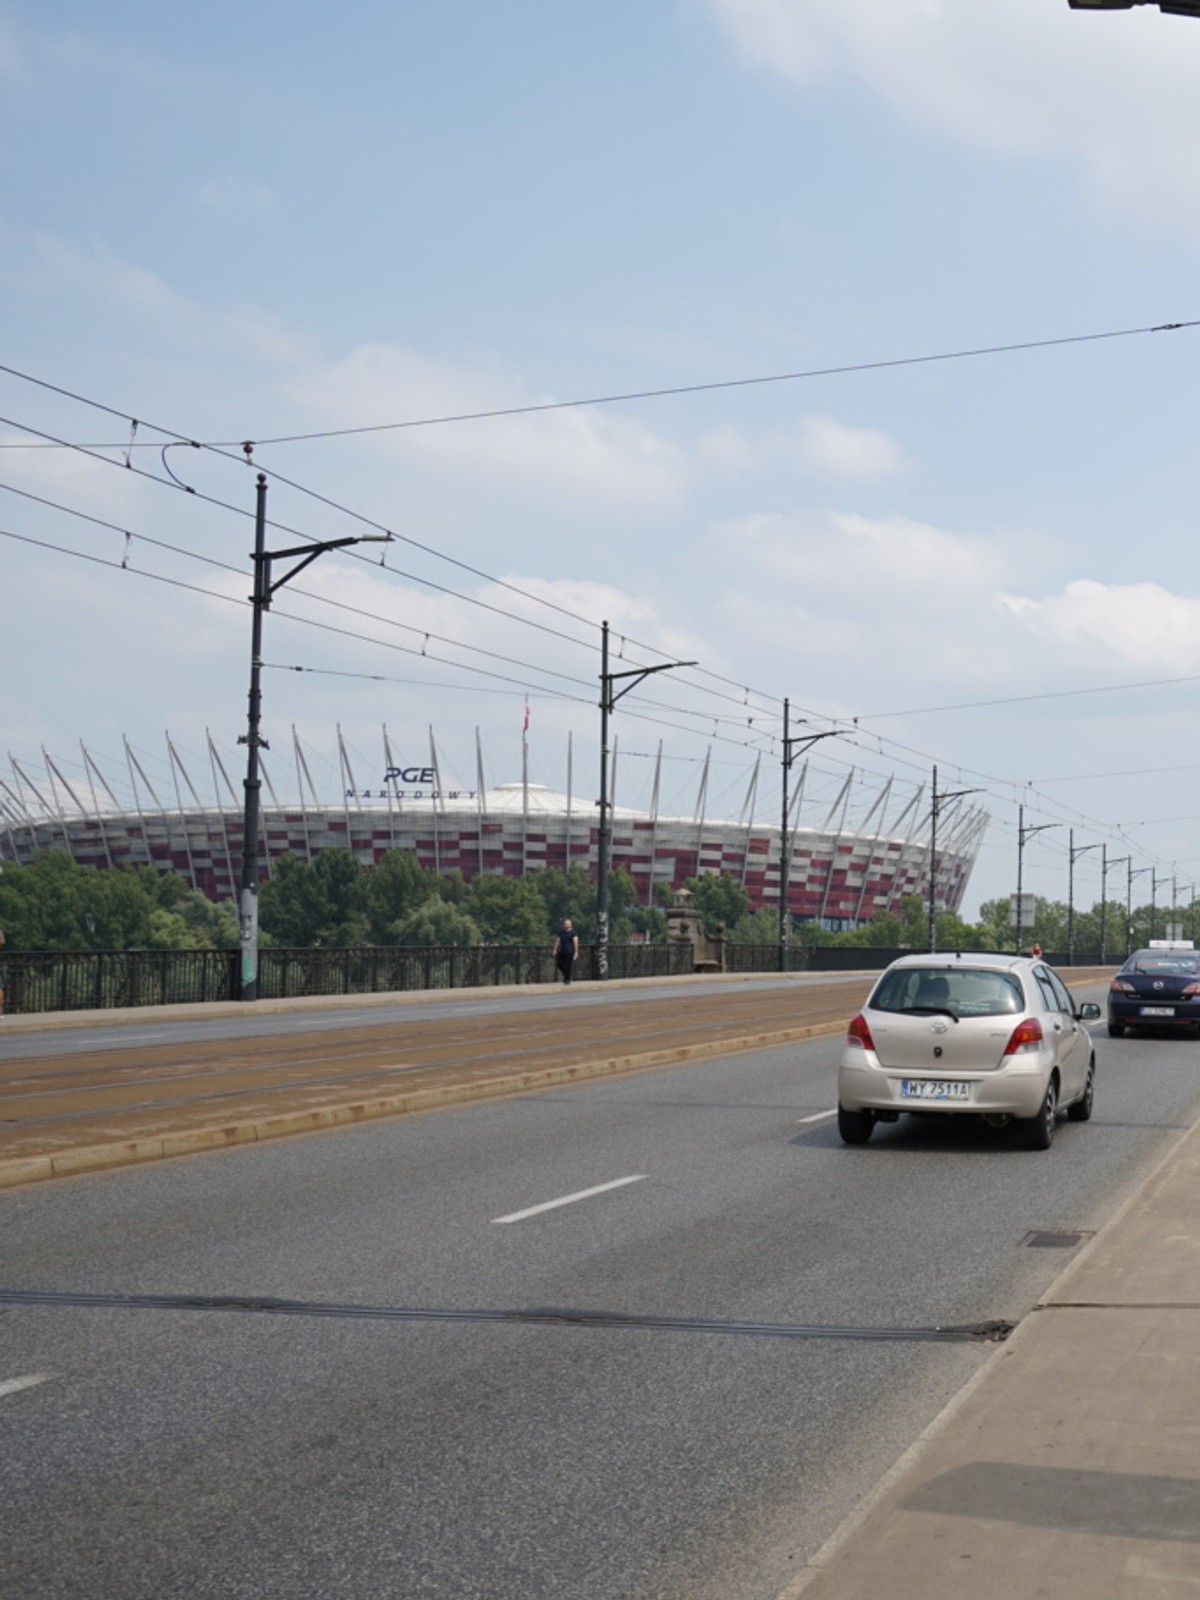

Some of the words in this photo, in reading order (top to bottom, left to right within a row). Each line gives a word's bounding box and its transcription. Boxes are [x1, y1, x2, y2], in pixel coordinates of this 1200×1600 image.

[383, 767, 435, 783] PGE
[344, 790, 476, 799] NARODOWY
[909, 1082, 926, 1093] WY
[930, 1083, 966, 1094] 7511A
